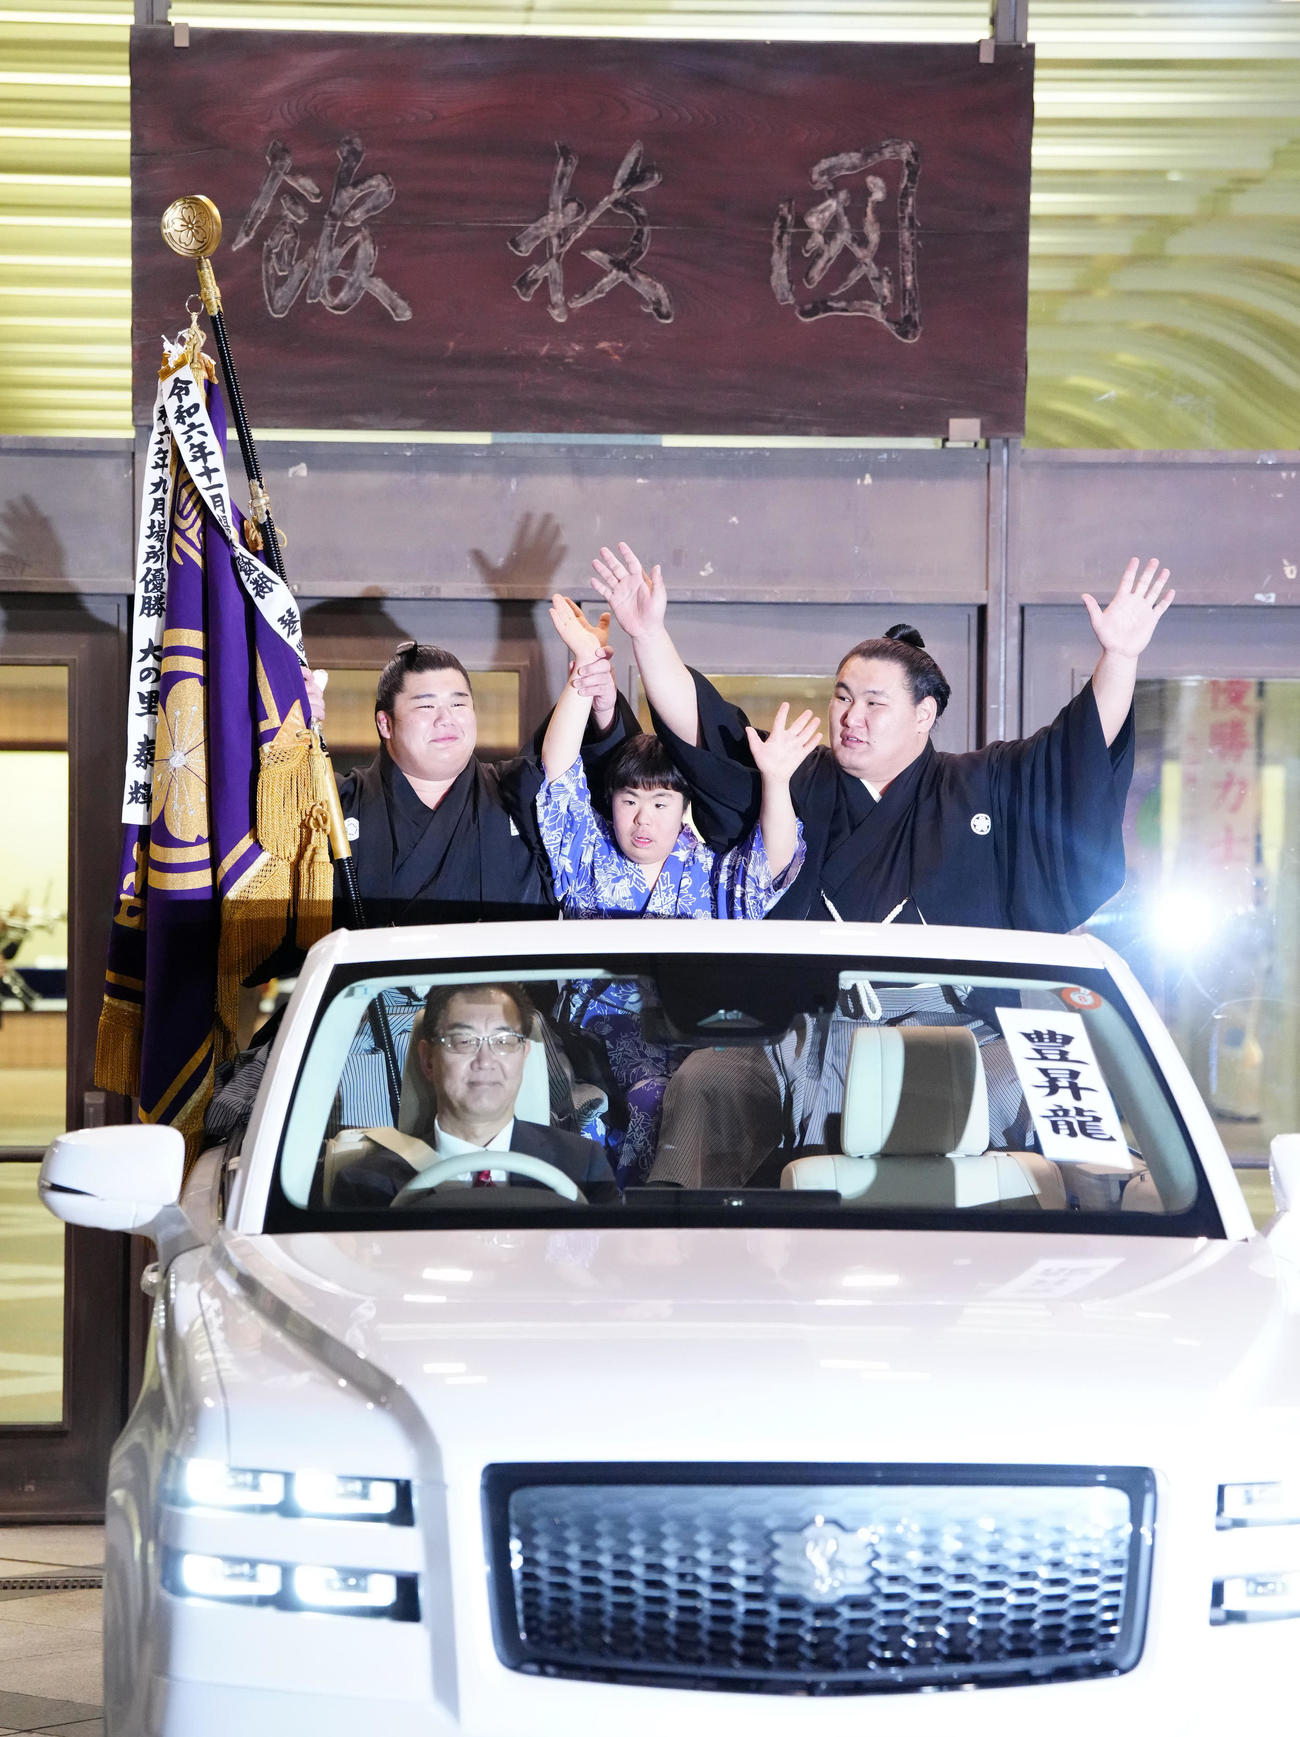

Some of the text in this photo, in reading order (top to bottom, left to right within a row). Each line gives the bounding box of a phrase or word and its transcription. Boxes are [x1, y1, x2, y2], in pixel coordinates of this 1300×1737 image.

[135, 638, 163, 717] 大の里
[1017, 1029, 1117, 1142] 豊昇龍
